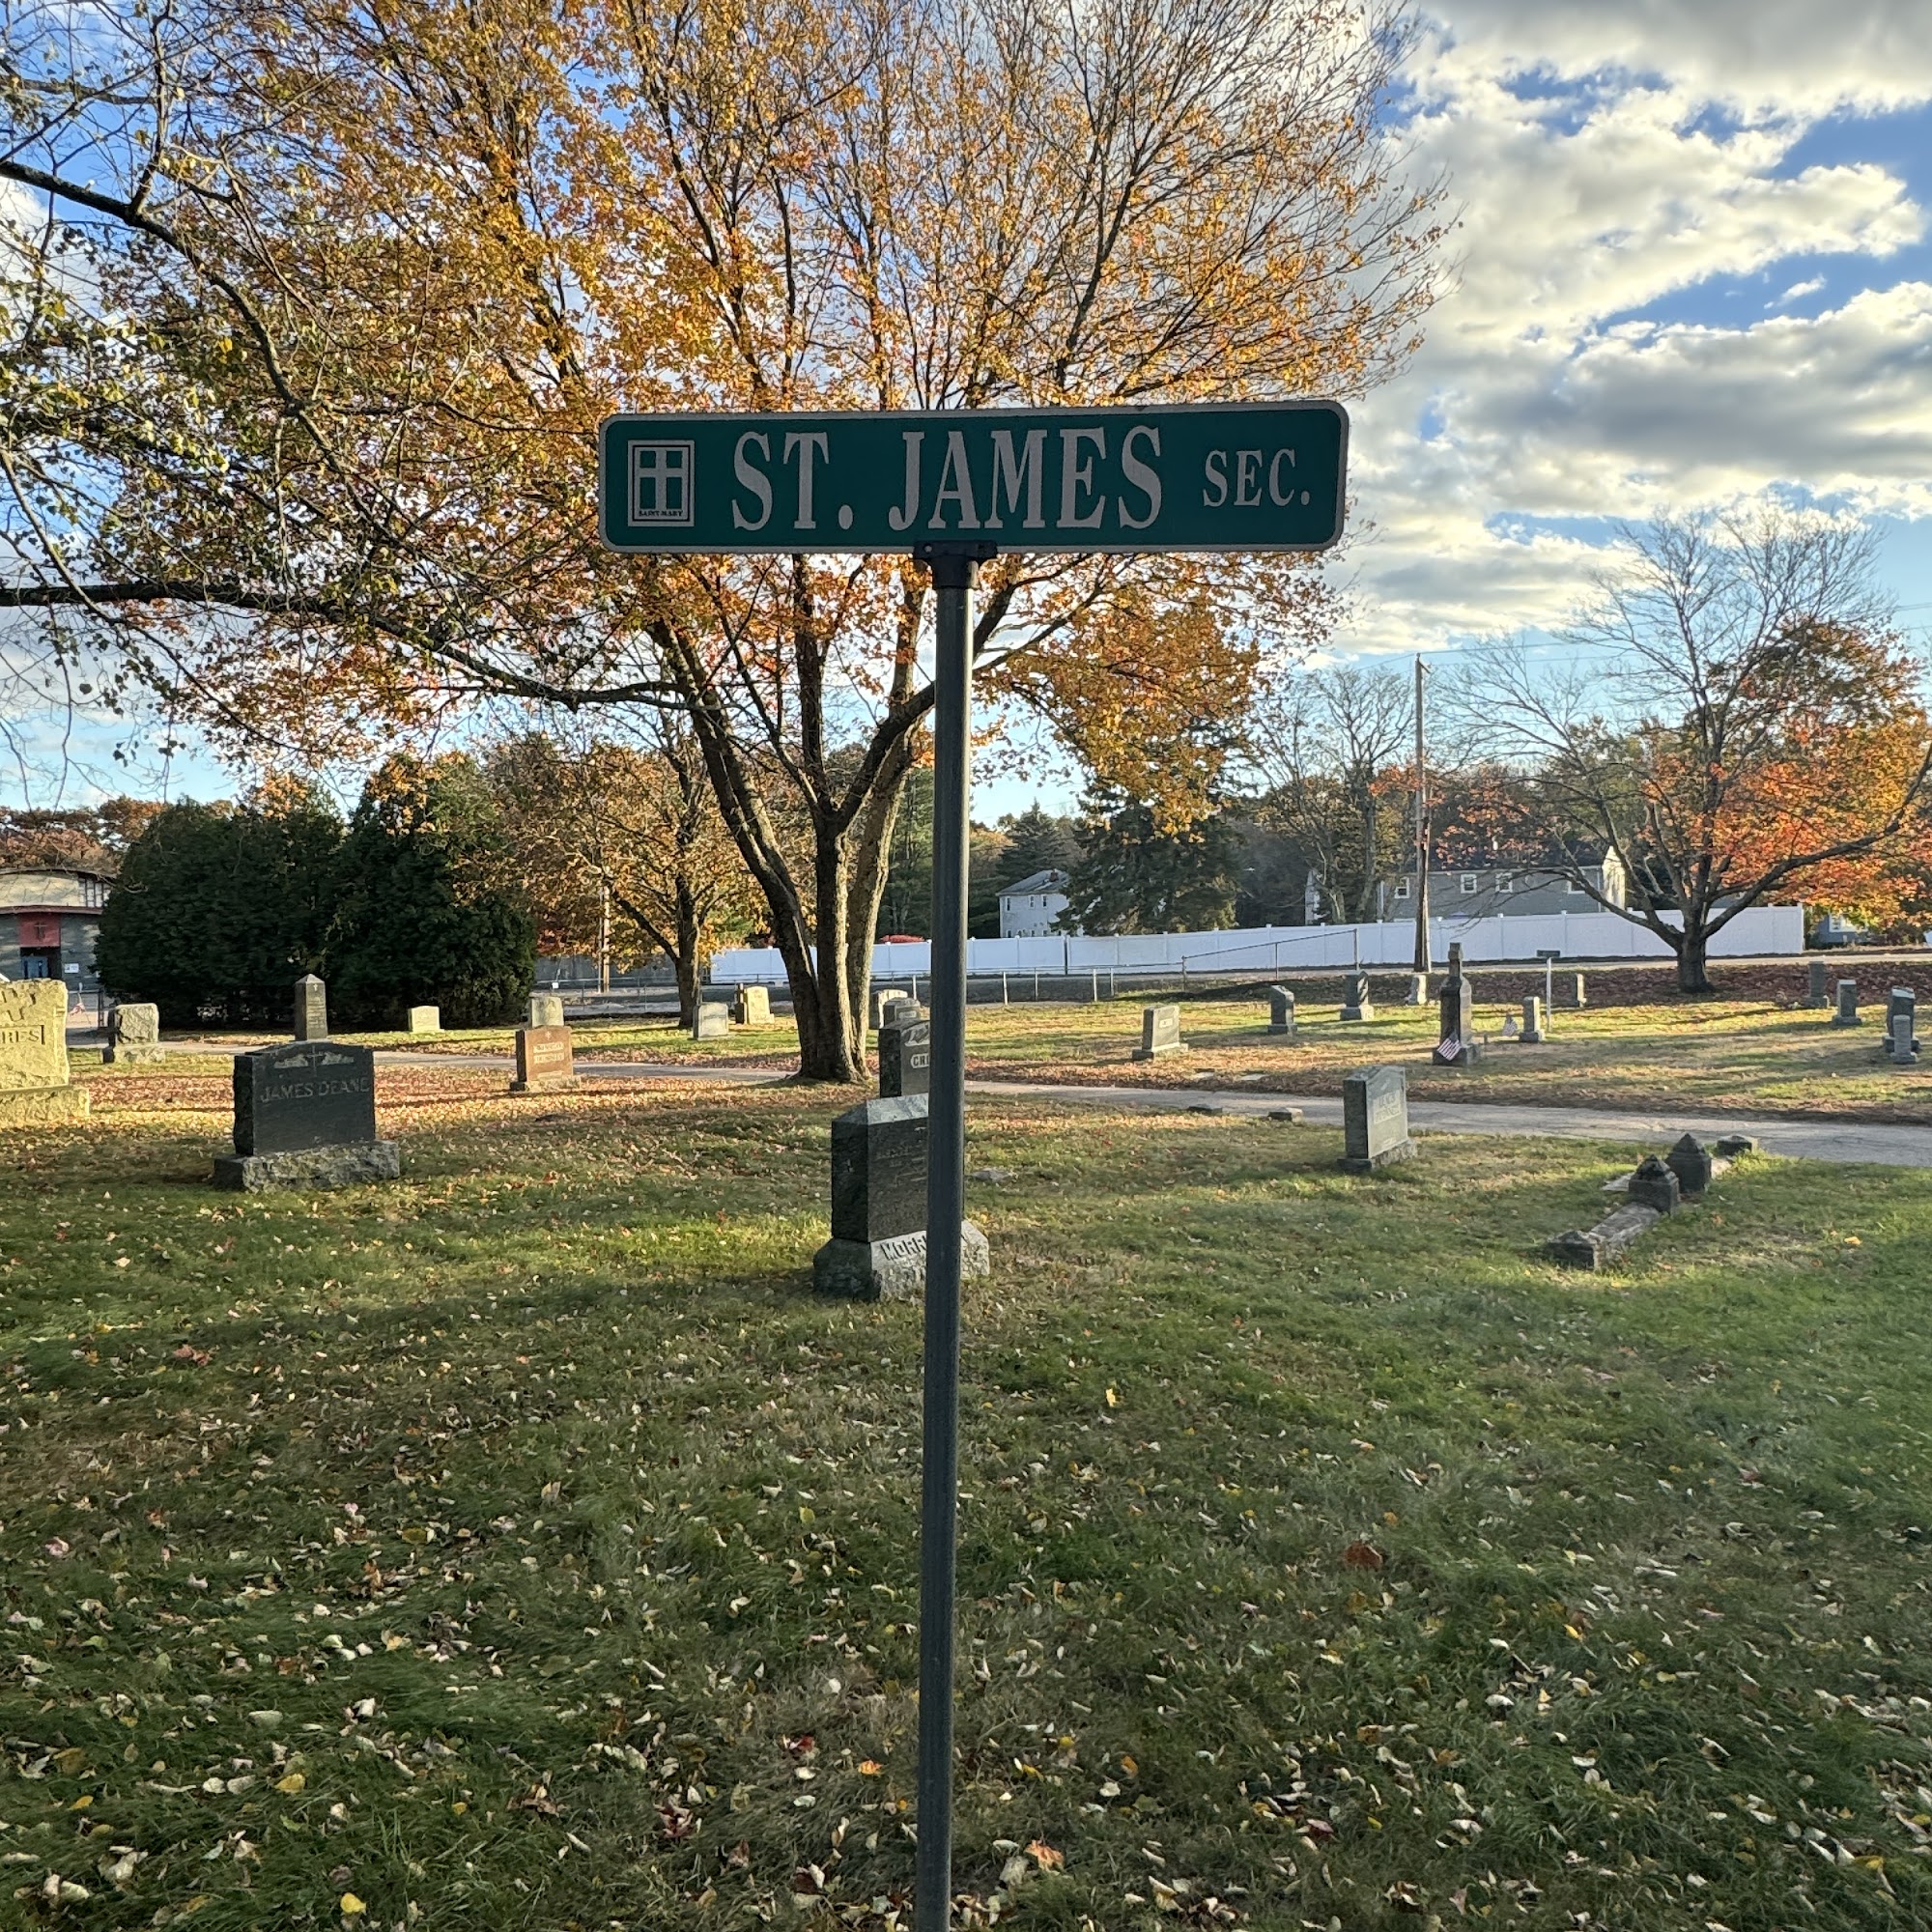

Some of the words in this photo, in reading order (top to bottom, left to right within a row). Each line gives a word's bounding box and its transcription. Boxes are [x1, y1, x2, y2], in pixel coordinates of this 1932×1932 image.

[731, 429, 855, 532] ST.
[887, 425, 1164, 532] JAMES
[1202, 447, 1313, 509] SEC.
[259, 1081, 314, 1103] JAMES
[318, 1076, 371, 1096] DEANE
